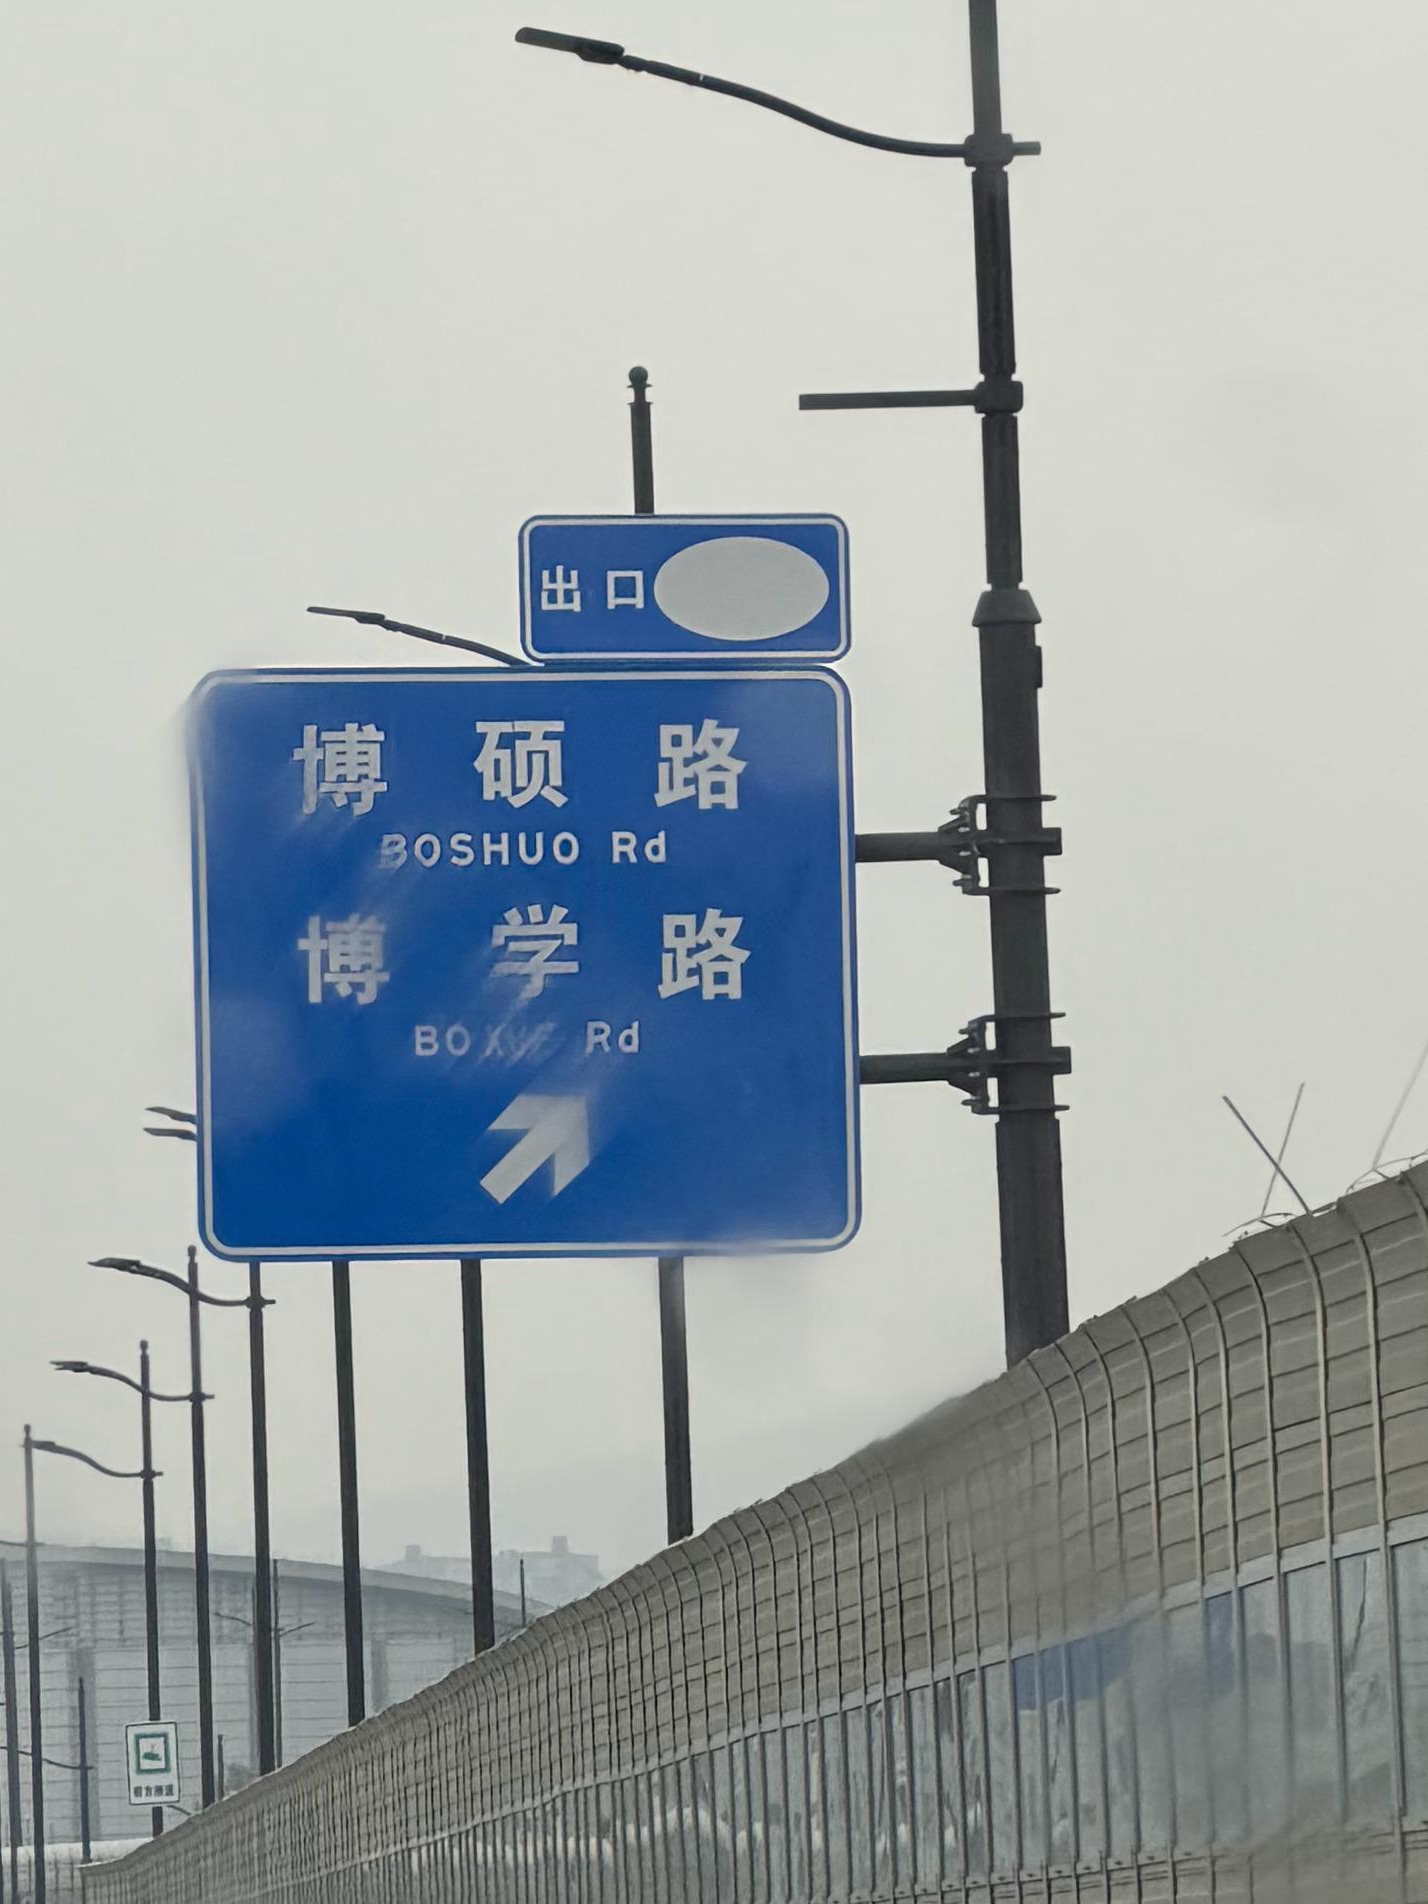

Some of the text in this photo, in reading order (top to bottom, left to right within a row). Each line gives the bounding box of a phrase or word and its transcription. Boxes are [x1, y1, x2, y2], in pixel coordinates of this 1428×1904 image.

[539, 565, 646, 613] 出口
[292, 719, 748, 816] 博硕路
[380, 829, 668, 870] BOSHUO Rd
[297, 904, 752, 1005] 博学路
[414, 1019, 641, 1062] BOX Rd
